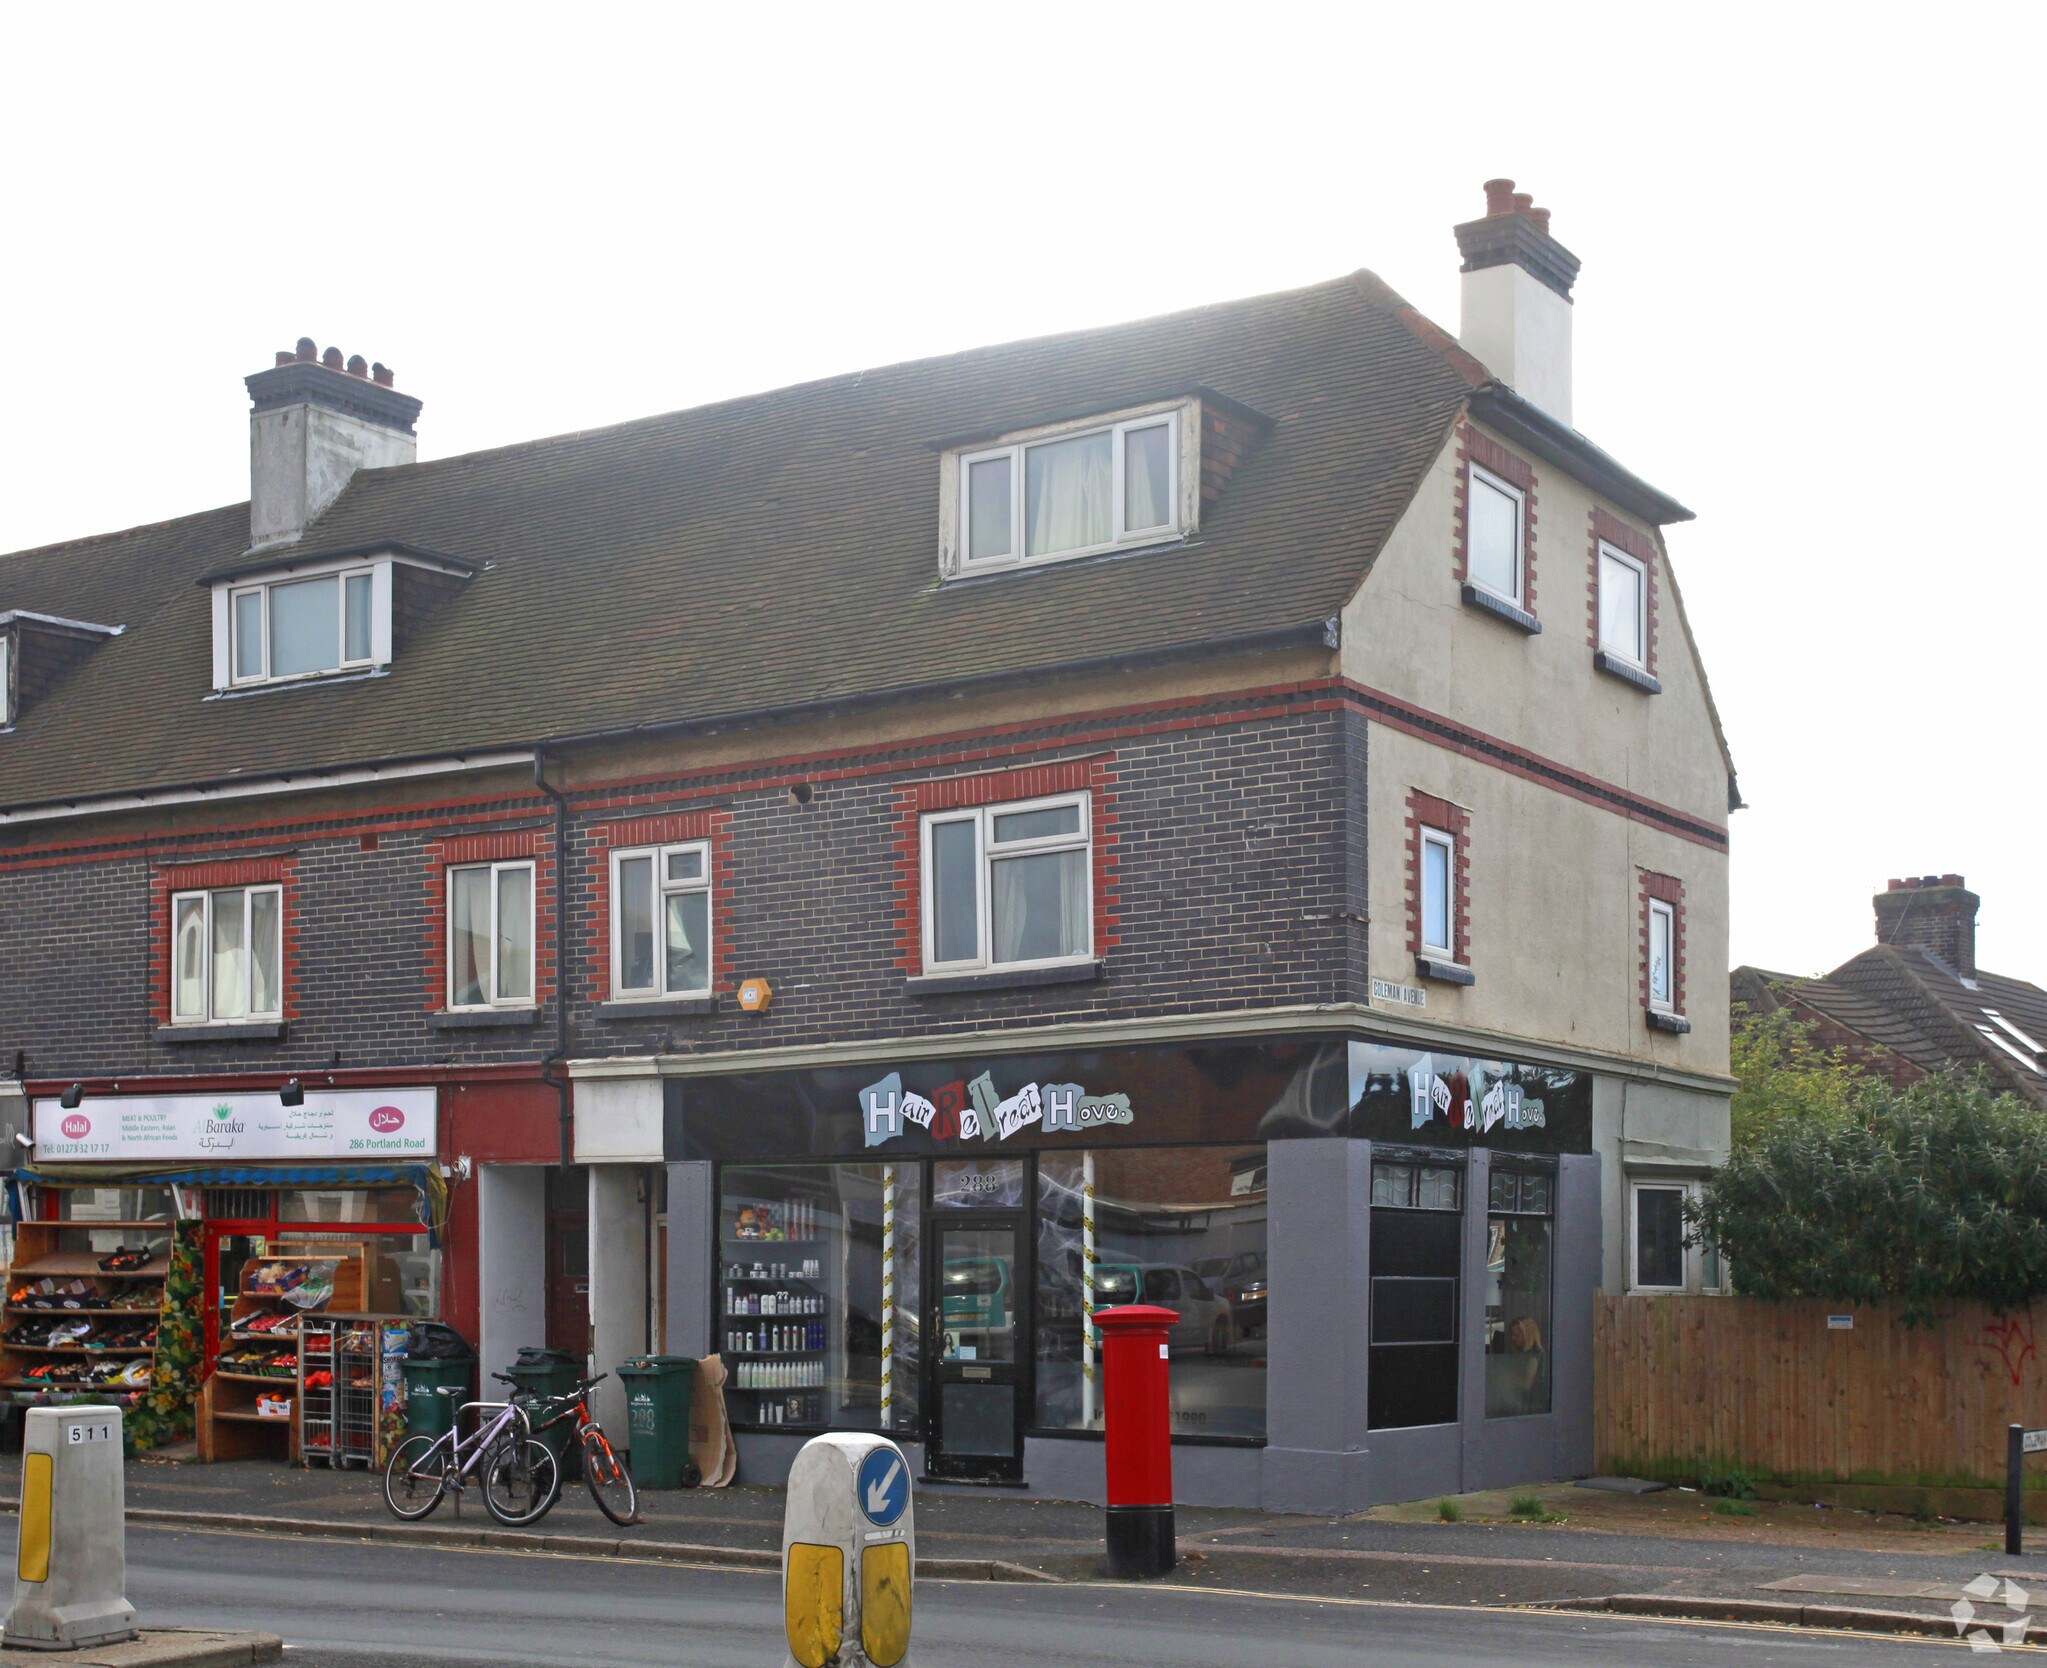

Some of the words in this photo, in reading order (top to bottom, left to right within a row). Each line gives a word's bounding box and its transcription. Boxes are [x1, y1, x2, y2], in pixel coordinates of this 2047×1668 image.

[1374, 981, 1400, 1001] COLEMAN
[1403, 987, 1424, 1006] AVENUE
[1414, 1071, 1448, 1115] Hair
[373, 1113, 400, 1127] حلال
[869, 1091, 931, 1133] Hair
[65, 1121, 87, 1133] Halal
[43, 1144, 54, 1153] Tel:
[57, 1144, 78, 1153] 01273
[80, 1144, 88, 1153] 32
[91, 1144, 98, 1153] 17
[101, 1144, 109, 1153] 17
[350, 1139, 364, 1149] 286
[366, 1138, 401, 1149] Portland
[404, 1138, 425, 1148] Road
[960, 1175, 997, 1194] 288
